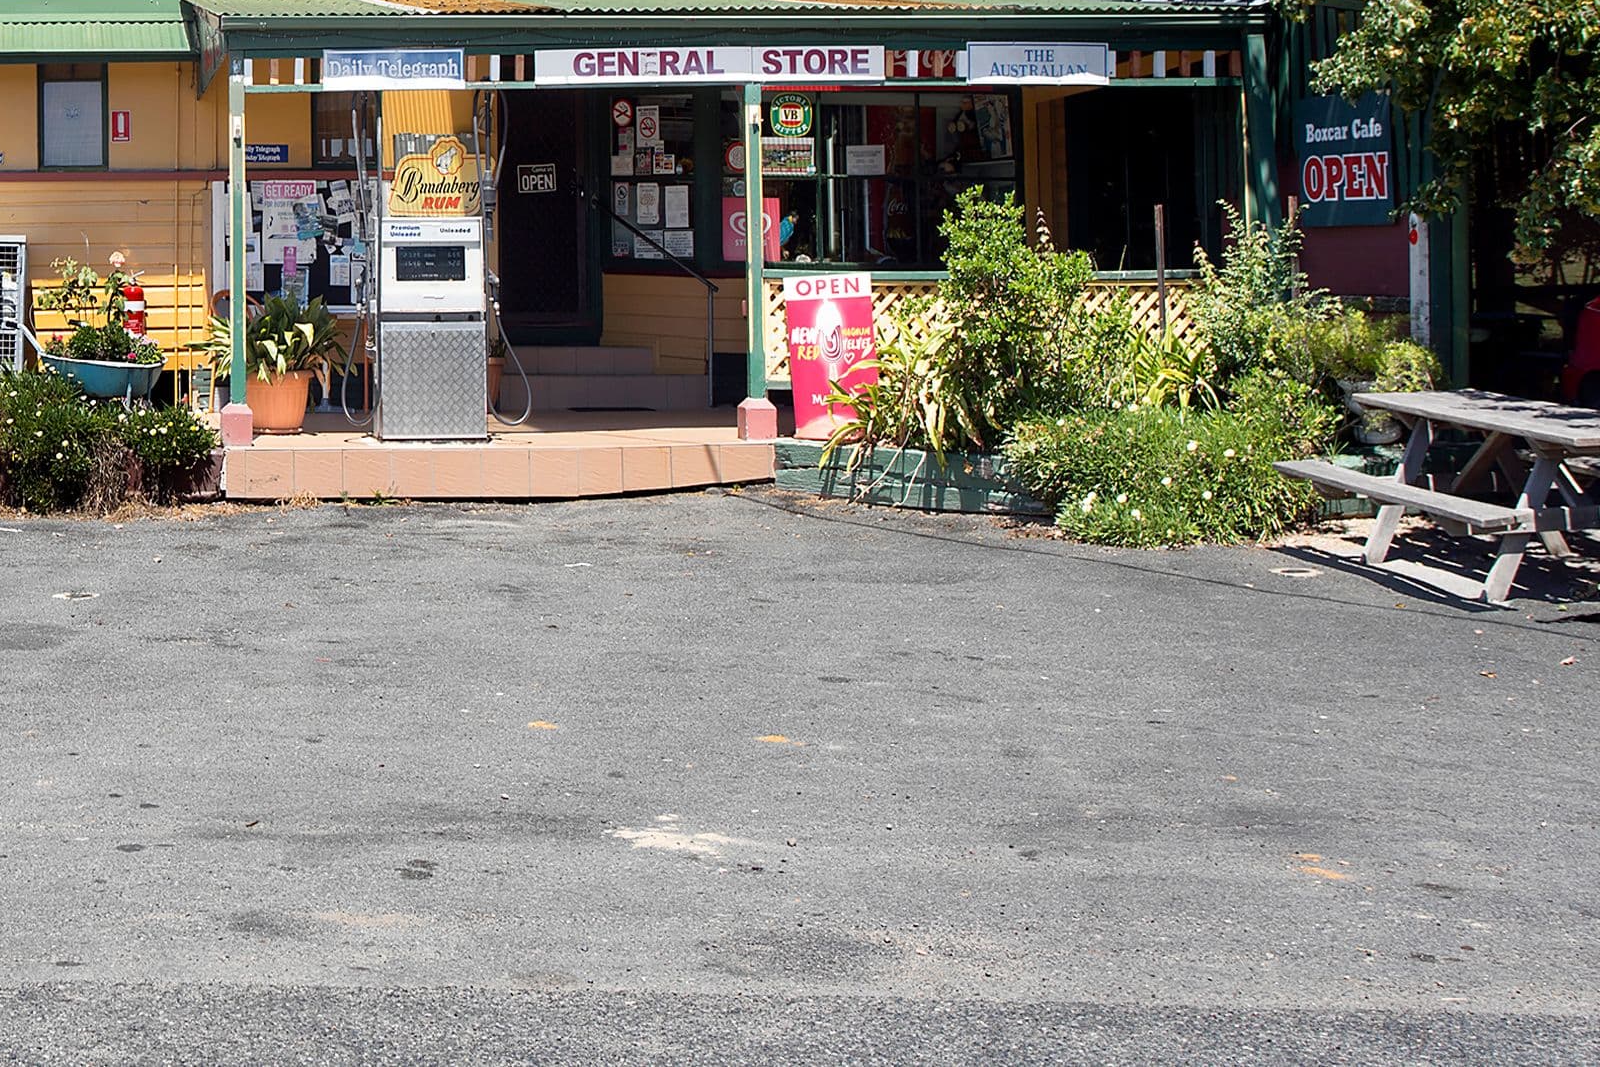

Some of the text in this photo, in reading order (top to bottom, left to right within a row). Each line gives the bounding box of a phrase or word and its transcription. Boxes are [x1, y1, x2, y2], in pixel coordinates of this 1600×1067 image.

[762, 49, 870, 75] STORE
[1024, 49, 1055, 63] THE
[329, 58, 459, 78] Daily Telegraph
[989, 62, 1088, 77] AUSTRALIAN
[784, 109, 798, 120] VB
[775, 122, 808, 135] BITTER
[1305, 117, 1382, 143] Boxcar Cafe
[396, 166, 480, 204] Bundaberg
[521, 173, 553, 191] OPEN
[1303, 151, 1388, 203] OPEN
[265, 184, 313, 197] GET READY
[421, 196, 462, 210] RUM
[795, 277, 860, 296] OPEN
[791, 325, 819, 345] NEW
[797, 345, 820, 361] RED
